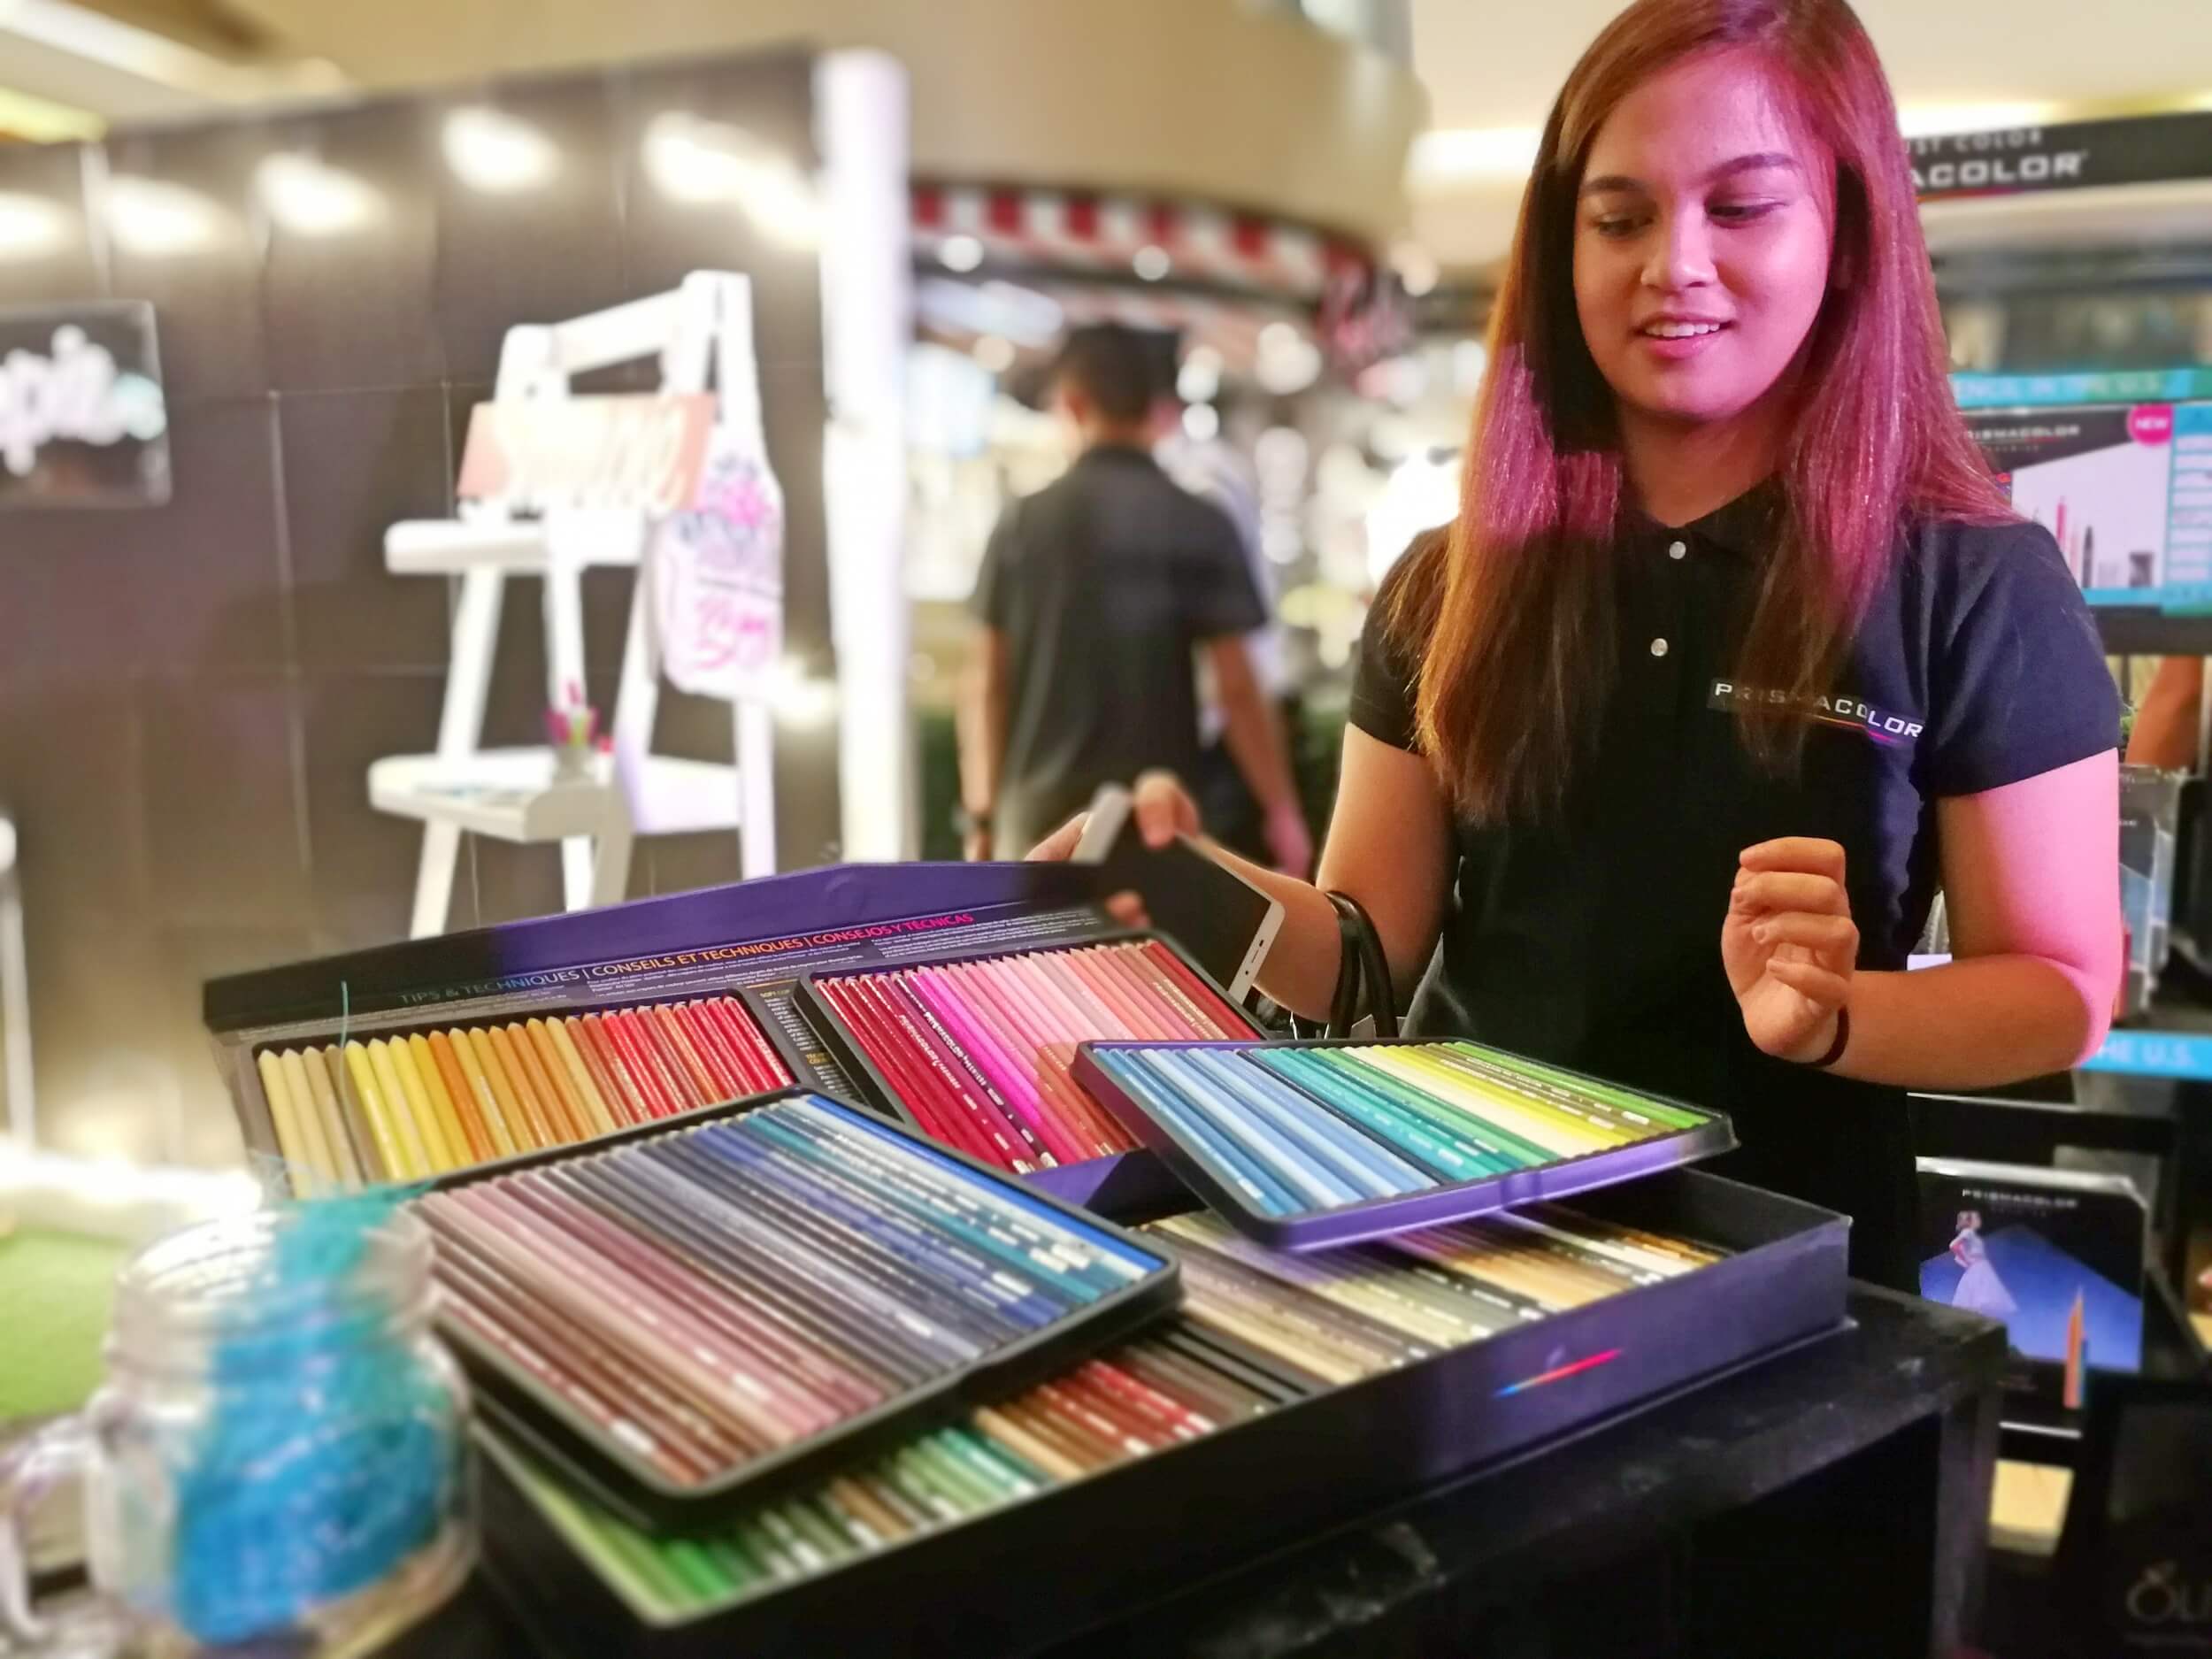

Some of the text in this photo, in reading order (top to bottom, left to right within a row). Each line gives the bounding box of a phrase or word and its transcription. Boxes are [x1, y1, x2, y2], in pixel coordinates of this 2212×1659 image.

[2135, 416, 2168, 430] NEW
[1715, 682, 1923, 738] PRISACOLOR
[399, 990, 441, 1005] TIPS
[462, 970, 580, 995] TECHNIQUES
[592, 957, 675, 977] CONSEILS
[678, 953, 697, 965] ET
[696, 937, 803, 962] TECHNIQUES
[812, 926, 892, 945] CONSEJOS
